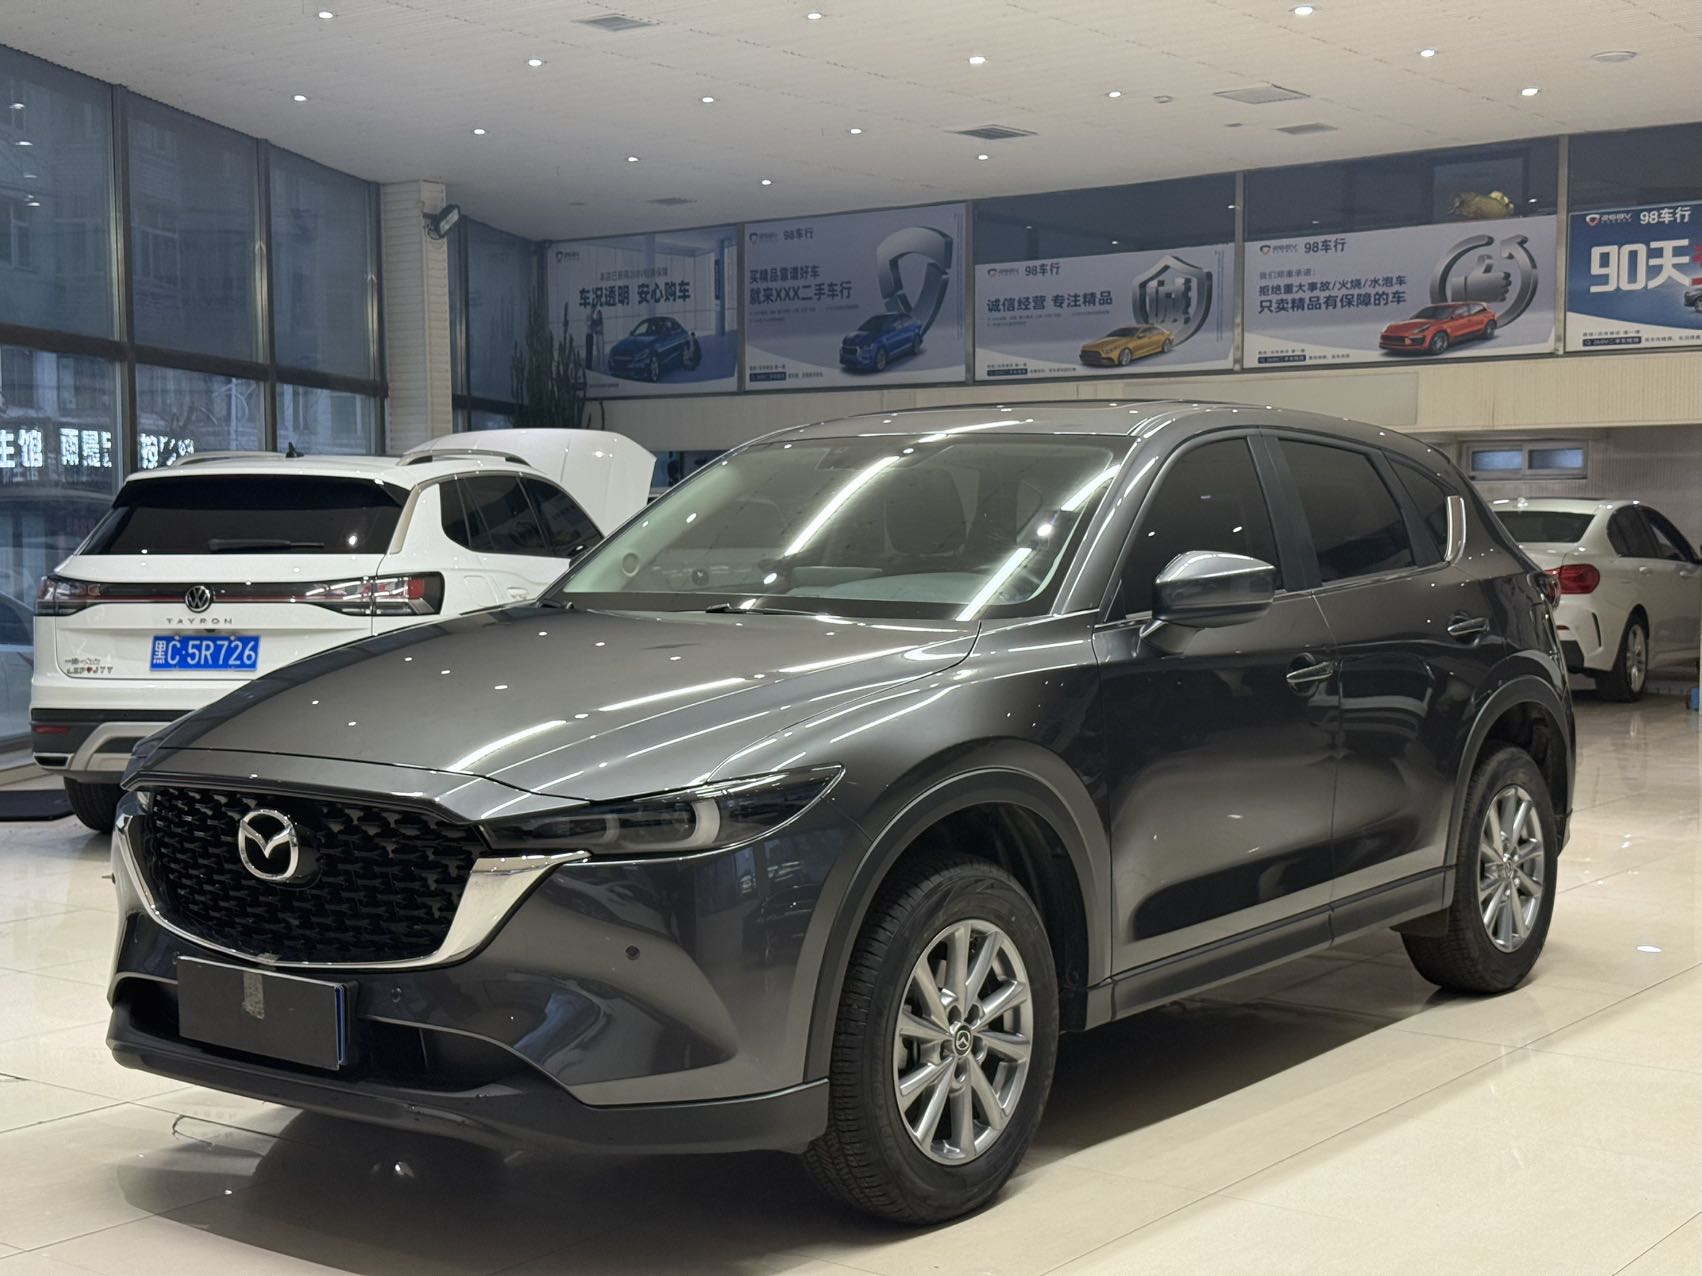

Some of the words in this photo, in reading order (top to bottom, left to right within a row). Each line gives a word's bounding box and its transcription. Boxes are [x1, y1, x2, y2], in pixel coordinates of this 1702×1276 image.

[1640, 207, 1691, 224] 98车行
[783, 228, 815, 240] 98车行
[1304, 238, 1347, 254] 98车行
[749, 265, 820, 285] 买精品靠谱好车
[1024, 262, 1061, 276] 98车行
[1590, 239, 1690, 293] 90天
[579, 284, 630, 309] 车况透明
[637, 280, 691, 305] 安心购车
[749, 281, 853, 305] 就来XXX二手车行
[1258, 275, 1407, 297] 拒绝重大事故/火烧/水泡车
[987, 295, 1047, 313] 诚信经营
[1051, 290, 1113, 309] 专注精品
[1258, 290, 1407, 315] 只卖精品有保障的车
